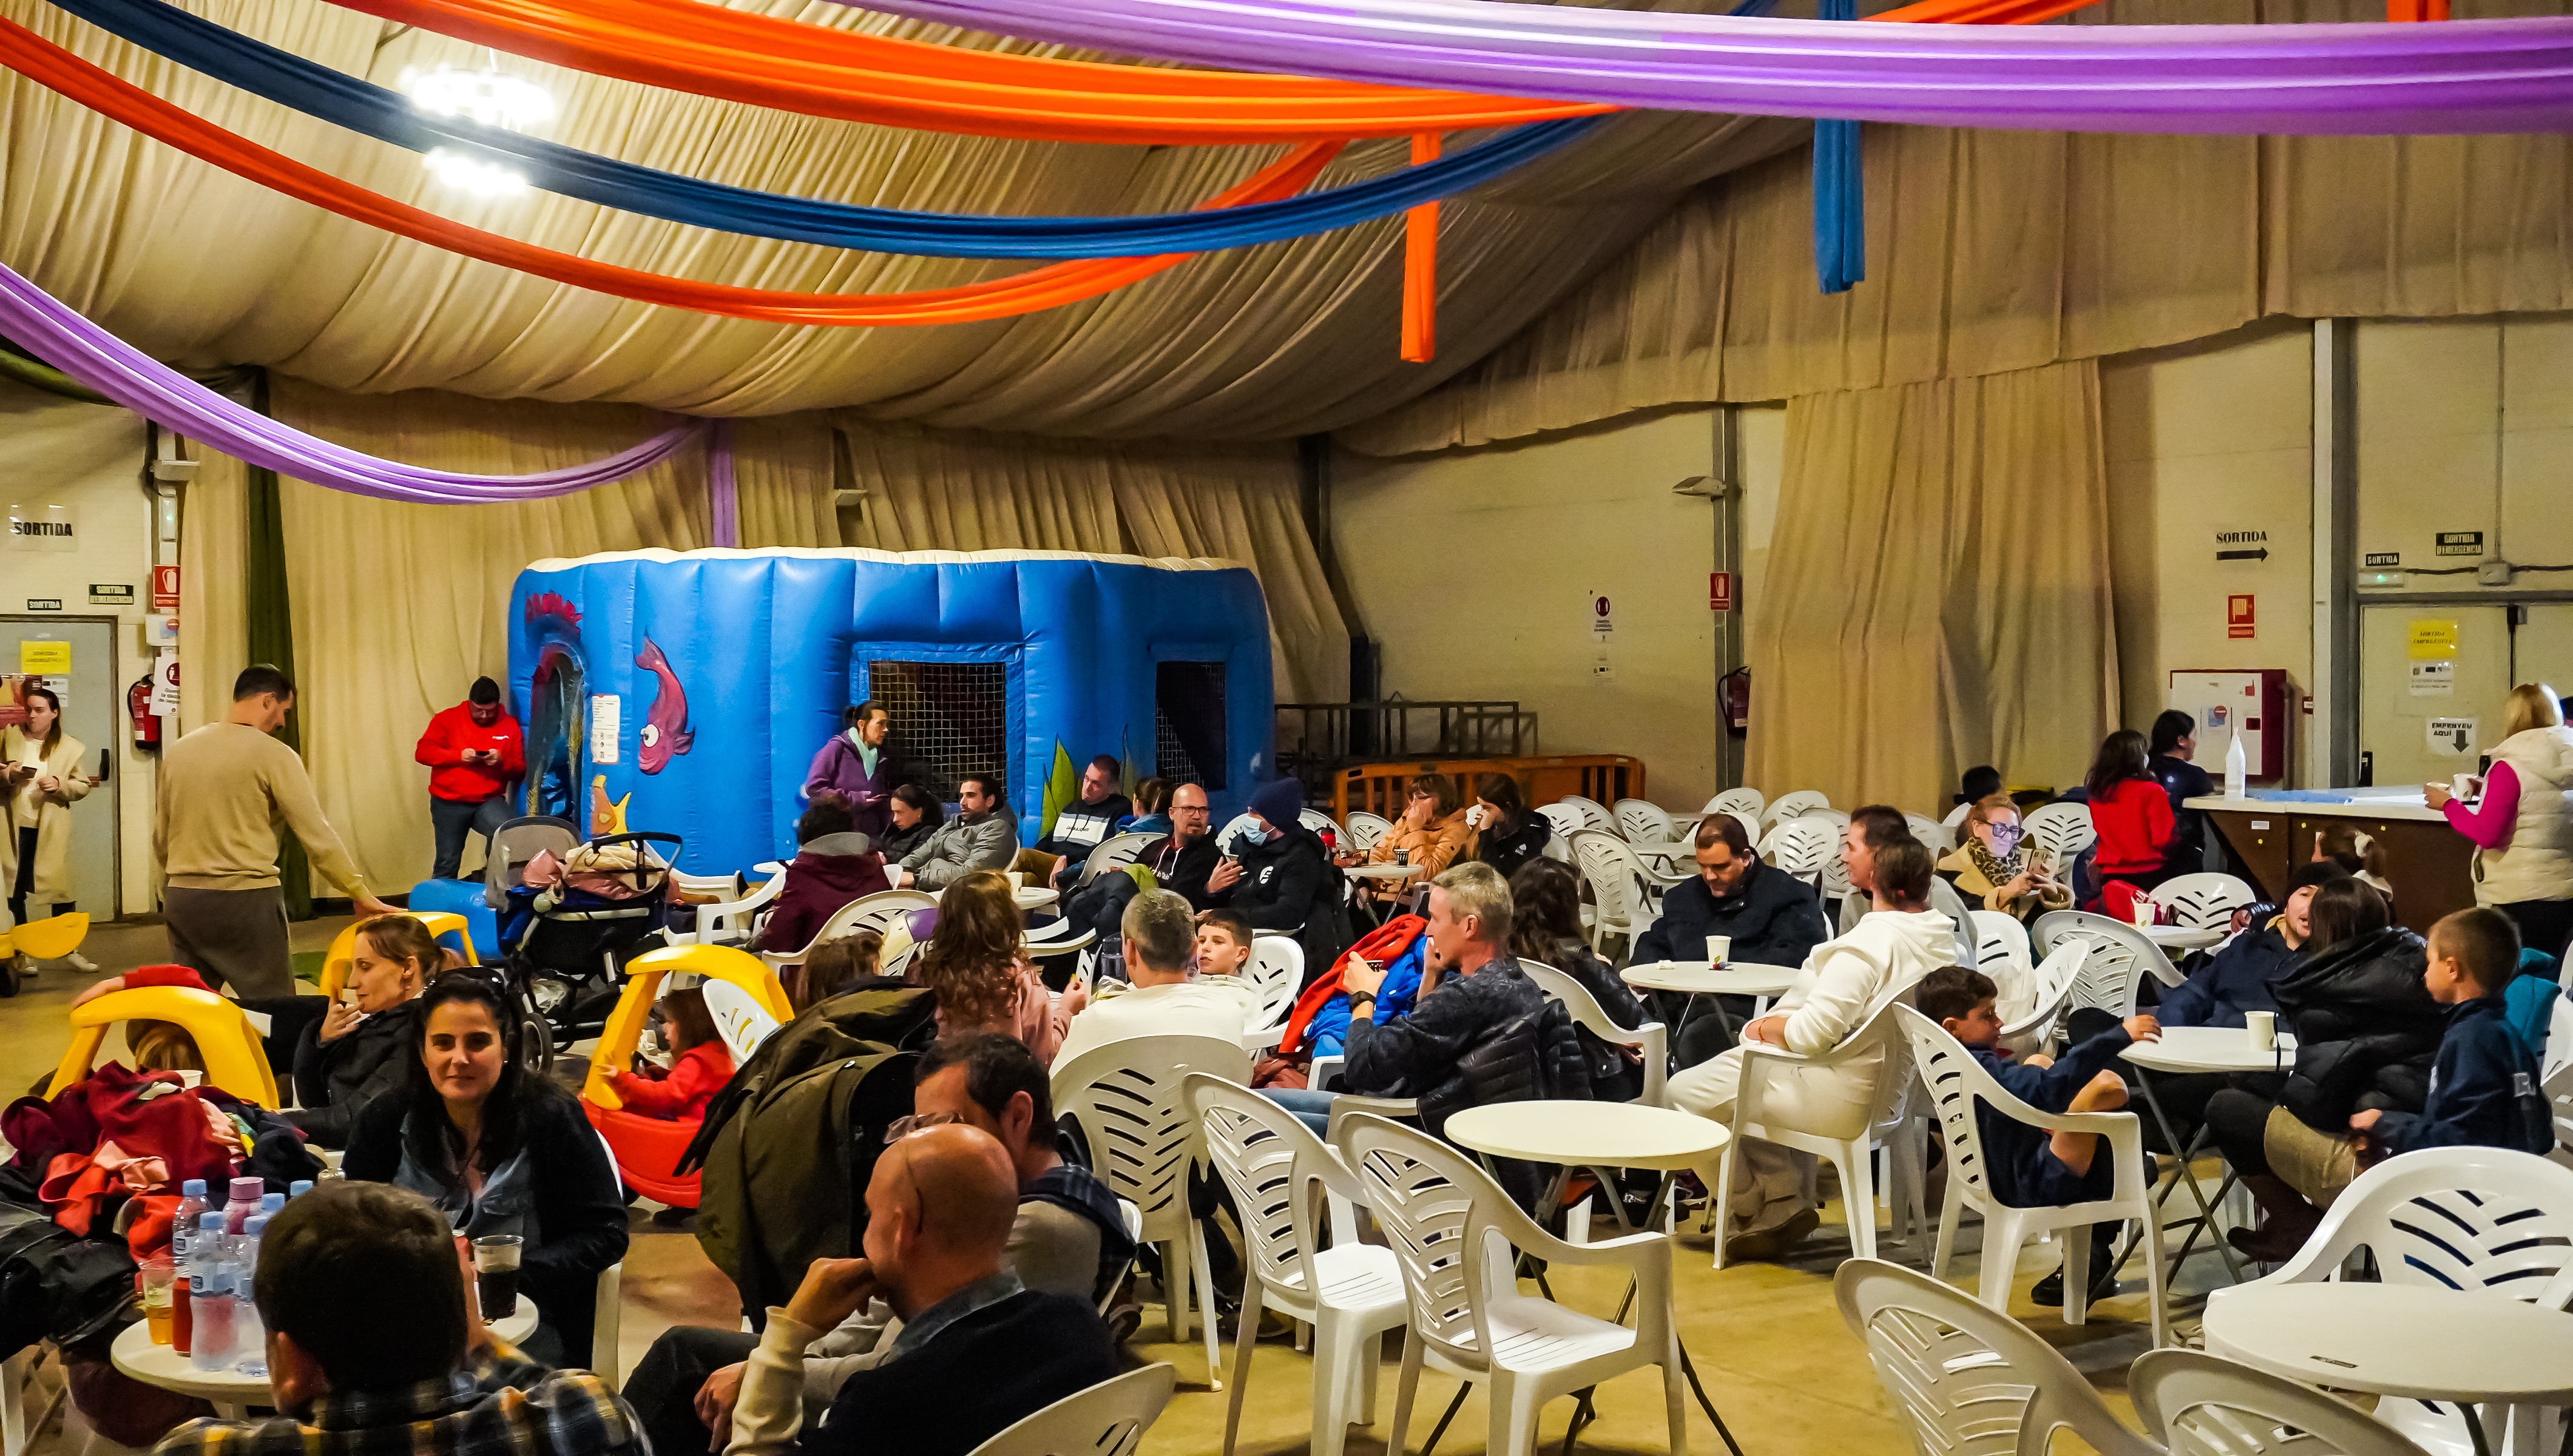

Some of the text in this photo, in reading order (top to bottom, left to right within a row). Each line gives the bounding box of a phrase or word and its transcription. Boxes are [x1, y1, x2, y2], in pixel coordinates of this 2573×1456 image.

[13, 522, 73, 536] SORTIDA
[2216, 531, 2268, 543] SORTIDA
[2367, 554, 2398, 564] SORTIDA
